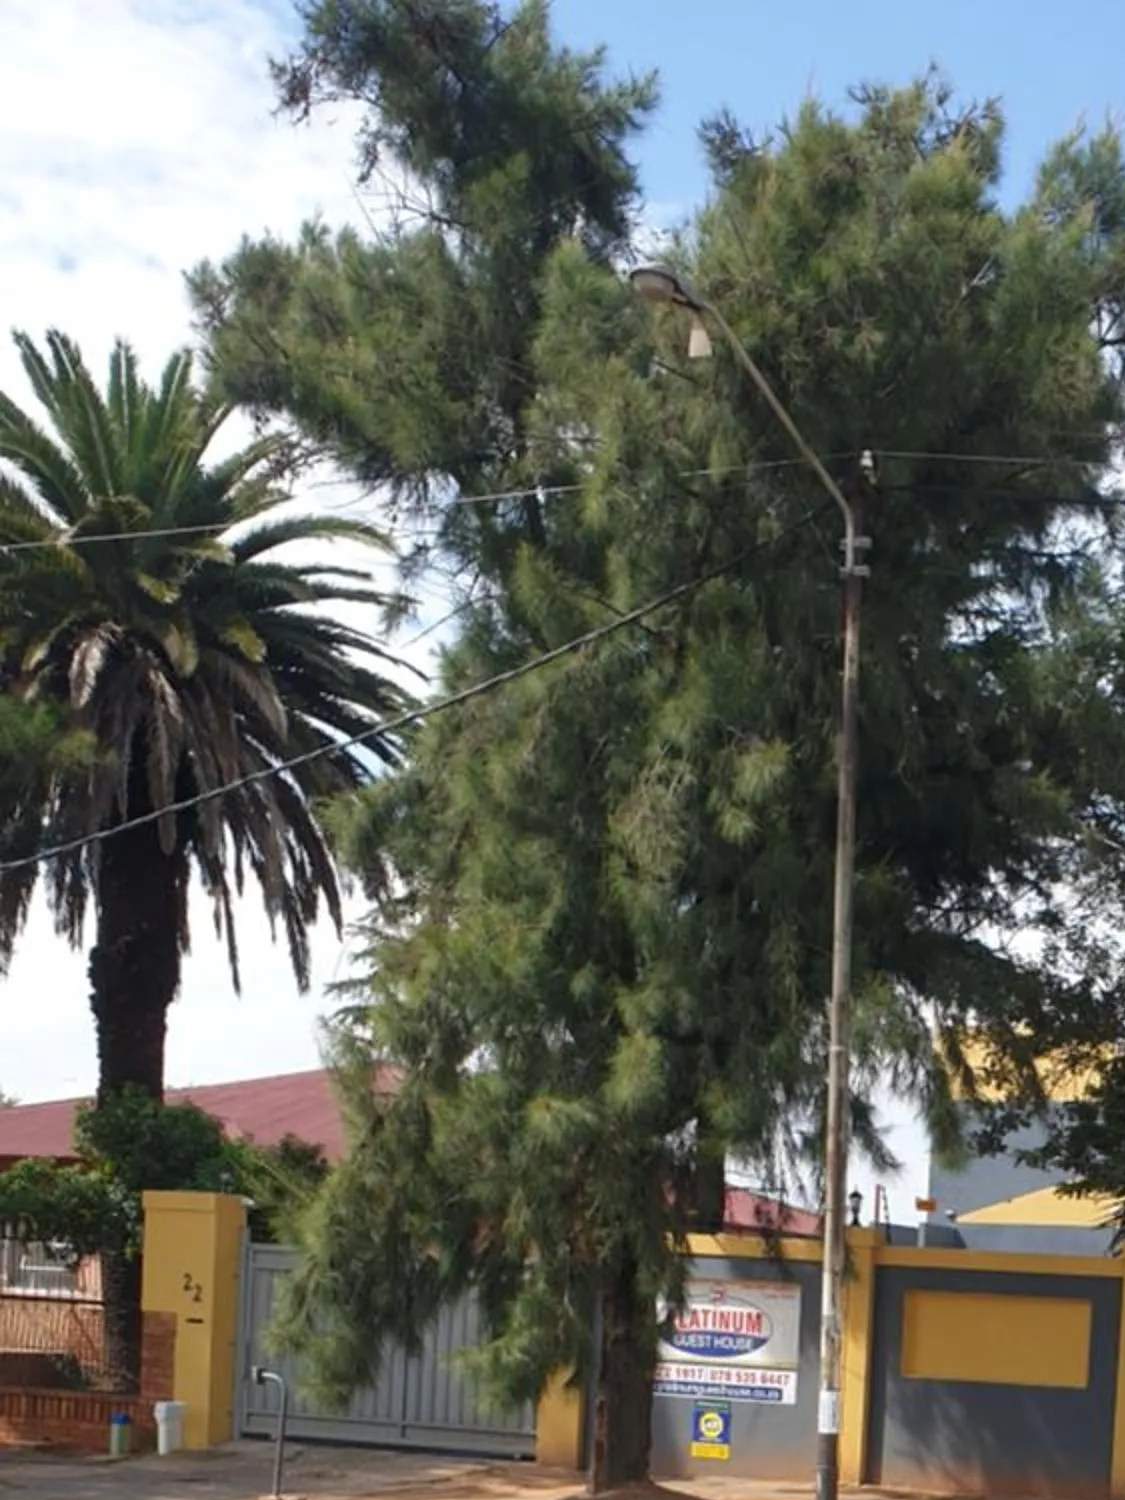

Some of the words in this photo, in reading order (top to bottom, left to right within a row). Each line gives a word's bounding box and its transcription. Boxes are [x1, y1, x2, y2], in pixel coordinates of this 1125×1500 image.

[674, 1307, 763, 1334] LATINUM
[673, 1333, 710, 1348] GUEST
[712, 1335, 754, 1351] HOUSE
